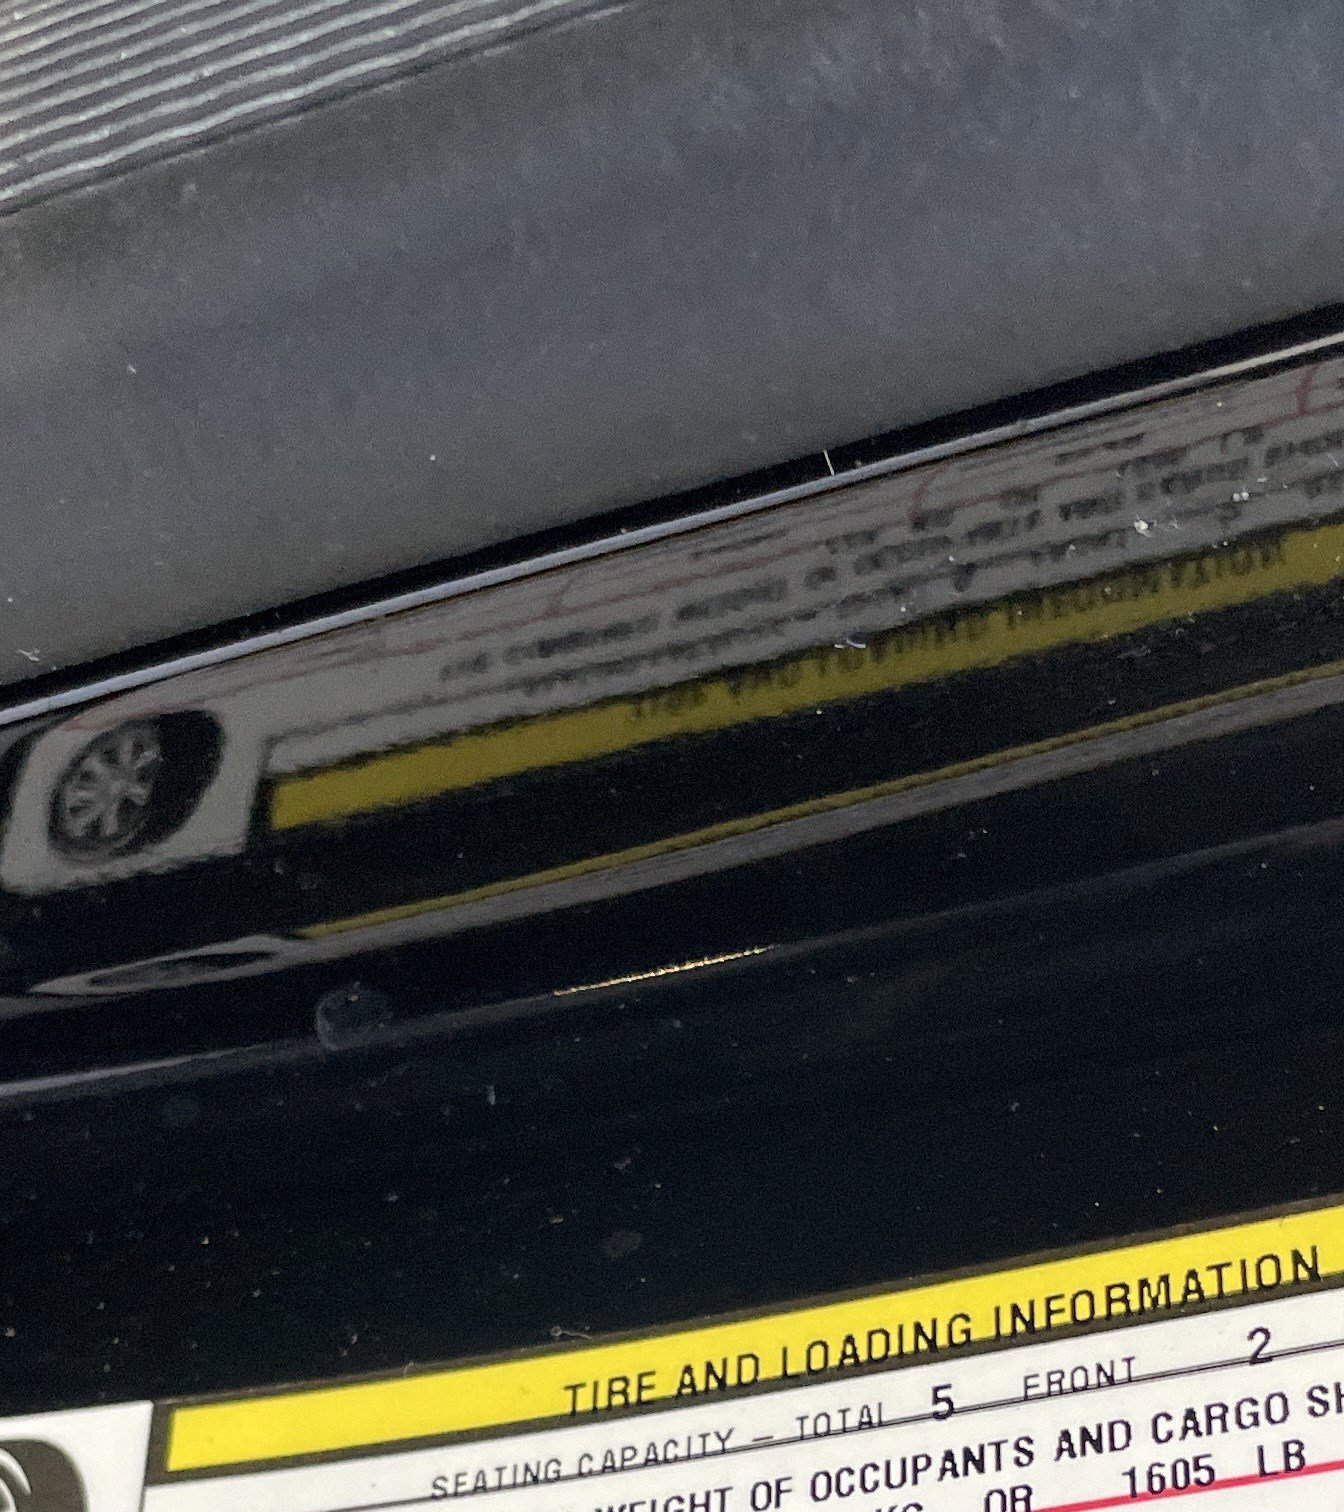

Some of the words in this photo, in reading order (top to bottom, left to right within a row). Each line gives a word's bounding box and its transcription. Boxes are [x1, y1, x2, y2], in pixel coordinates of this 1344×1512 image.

[565, 1371, 657, 1418] TIRE
[675, 1353, 760, 1400] AND
[781, 1313, 972, 1380] LOADING
[992, 1245, 1324, 1342] INFORMATION
[429, 1457, 563, 1500] SEATING
[577, 1427, 735, 1475] CAPACITY
[796, 1402, 887, 1442] TOTAL
[931, 1384, 957, 1420] 5
[1023, 1354, 1139, 1401] FRONT
[1246, 1327, 1275, 1364] 2
[750, 1477, 793, 1512] OF
[809, 1436, 1035, 1502] OCCUPANTS
[1053, 1417, 1134, 1463] AND
[1149, 1391, 1290, 1448] CARGO
[1121, 1456, 1216, 1501] 1605
[1256, 1439, 1309, 1478] LB
